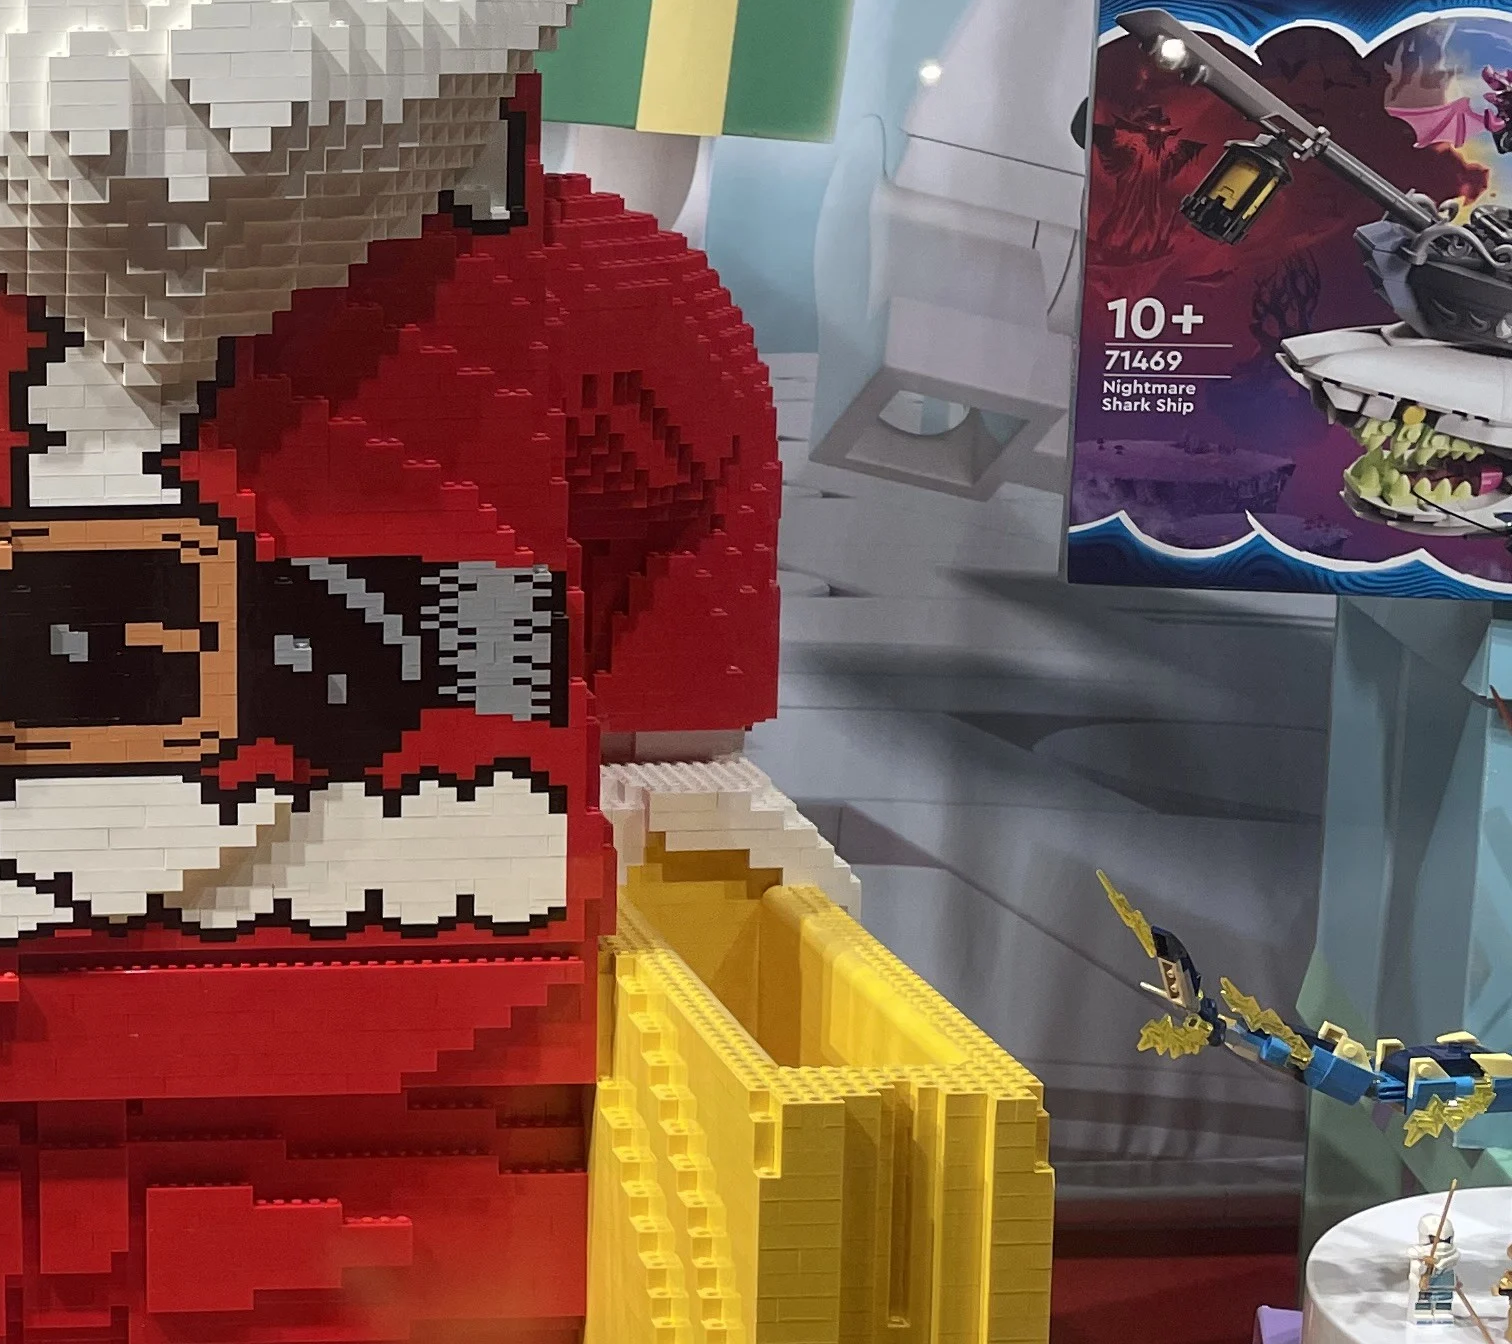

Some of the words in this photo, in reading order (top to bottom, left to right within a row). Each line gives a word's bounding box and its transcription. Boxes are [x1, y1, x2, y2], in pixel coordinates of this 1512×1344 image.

[1107, 297, 1204, 339] 10+
[1105, 350, 1183, 371] 71469
[1103, 379, 1196, 397] Nightmare
[1102, 397, 1151, 412] Shark
[1156, 397, 1195, 416] Ship
